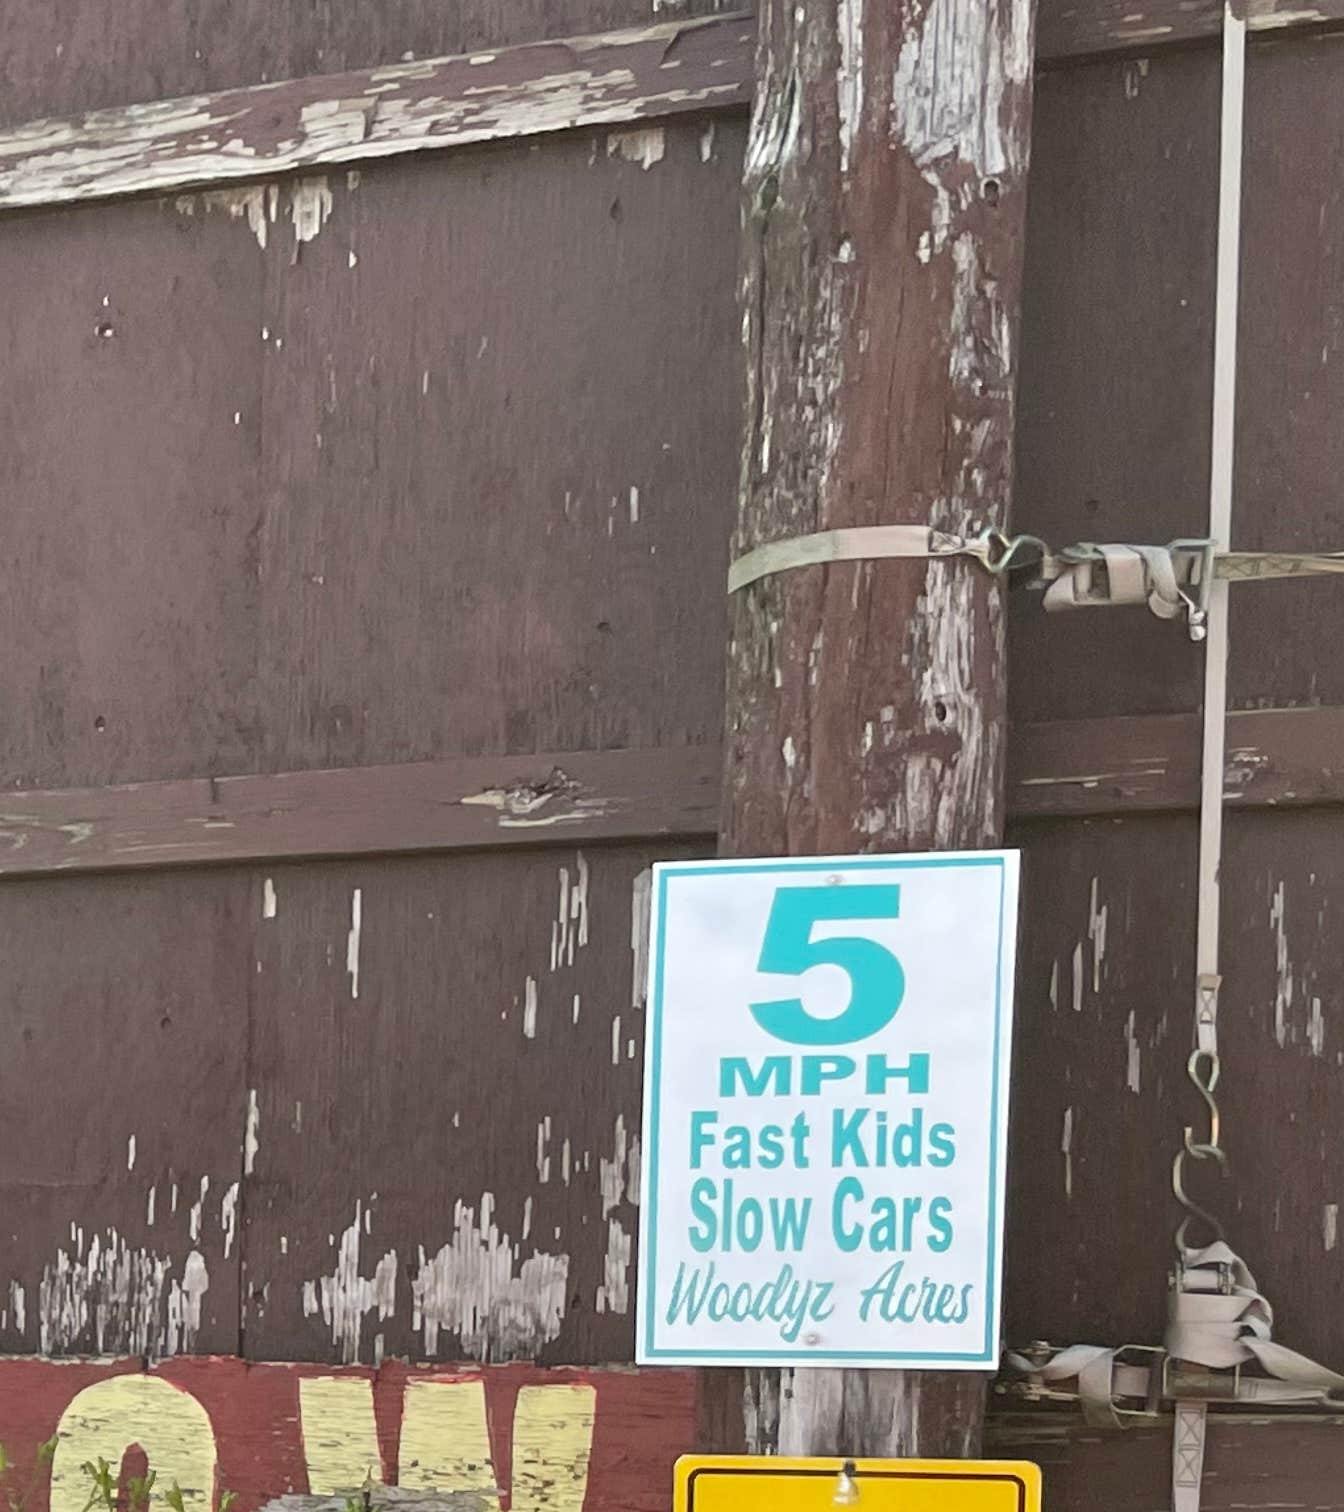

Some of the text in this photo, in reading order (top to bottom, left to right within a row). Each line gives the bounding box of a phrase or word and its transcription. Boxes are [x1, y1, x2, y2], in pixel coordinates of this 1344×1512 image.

[748, 883, 905, 1045] 5
[719, 1053, 930, 1096] MPH
[689, 1108, 955, 1169] Fast Kids
[688, 1176, 953, 1252] Slow Cars
[666, 1260, 974, 1343] Woodyz Acres
